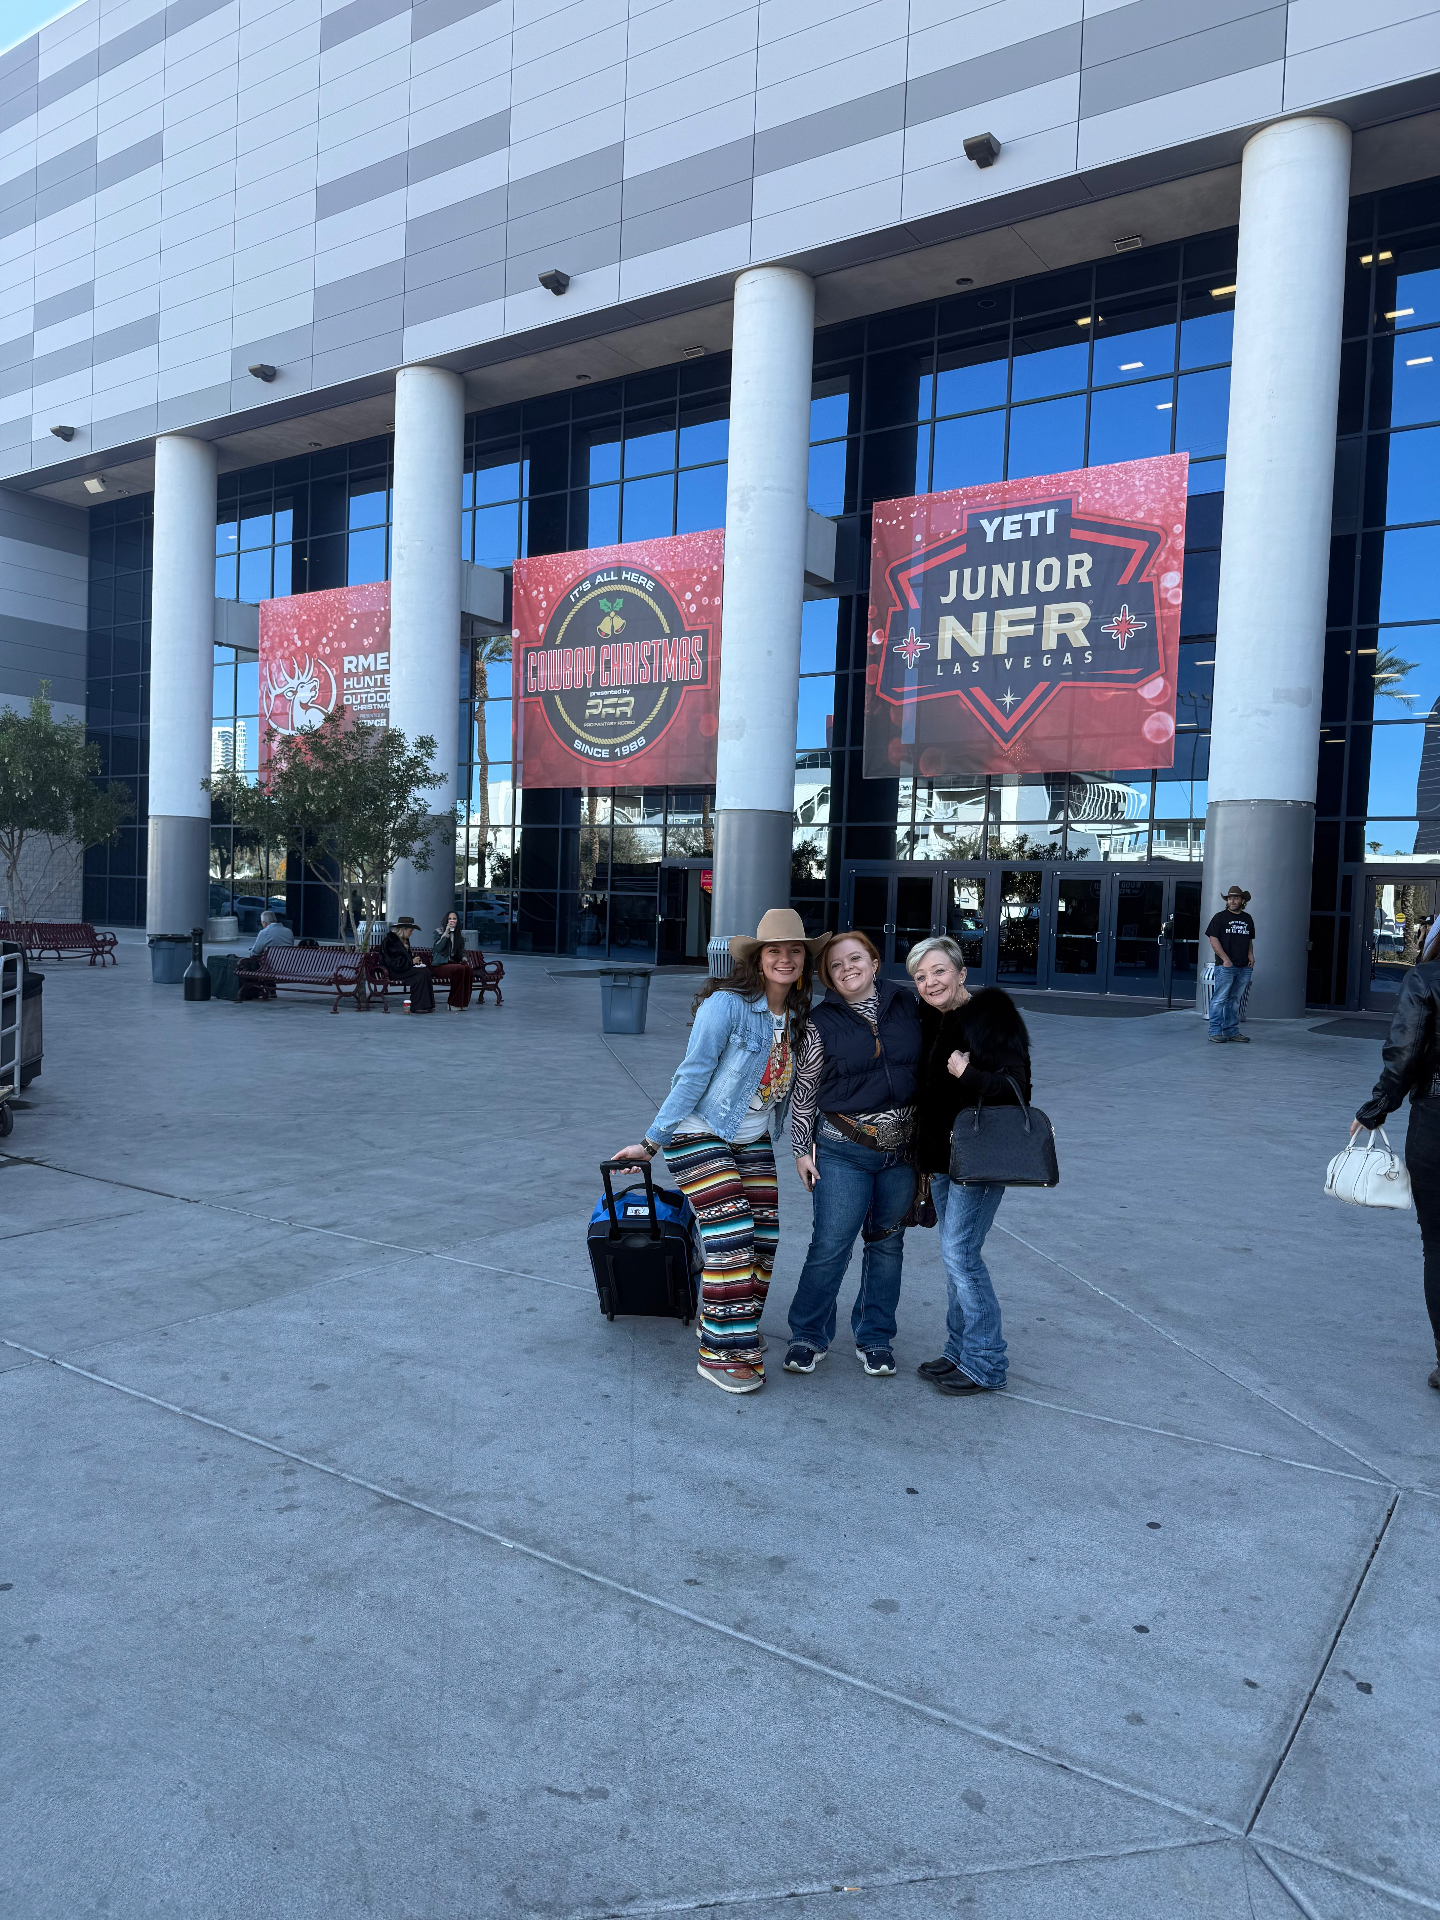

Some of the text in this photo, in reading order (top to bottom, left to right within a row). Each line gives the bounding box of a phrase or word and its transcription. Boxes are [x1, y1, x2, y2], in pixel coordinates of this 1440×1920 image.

[979, 509, 1055, 543] YETI
[569, 571, 656, 602] IT'S ALL HERE
[940, 552, 1093, 604] JUNIOR
[937, 601, 1092, 660] NFR
[527, 636, 702, 692] COWBOY CHRISTMAS
[937, 651, 1093, 676] LAS VEGAS
[585, 697, 634, 719] PFR
[590, 689, 621, 697] presented
[573, 736, 646, 758] SINCE 1986
